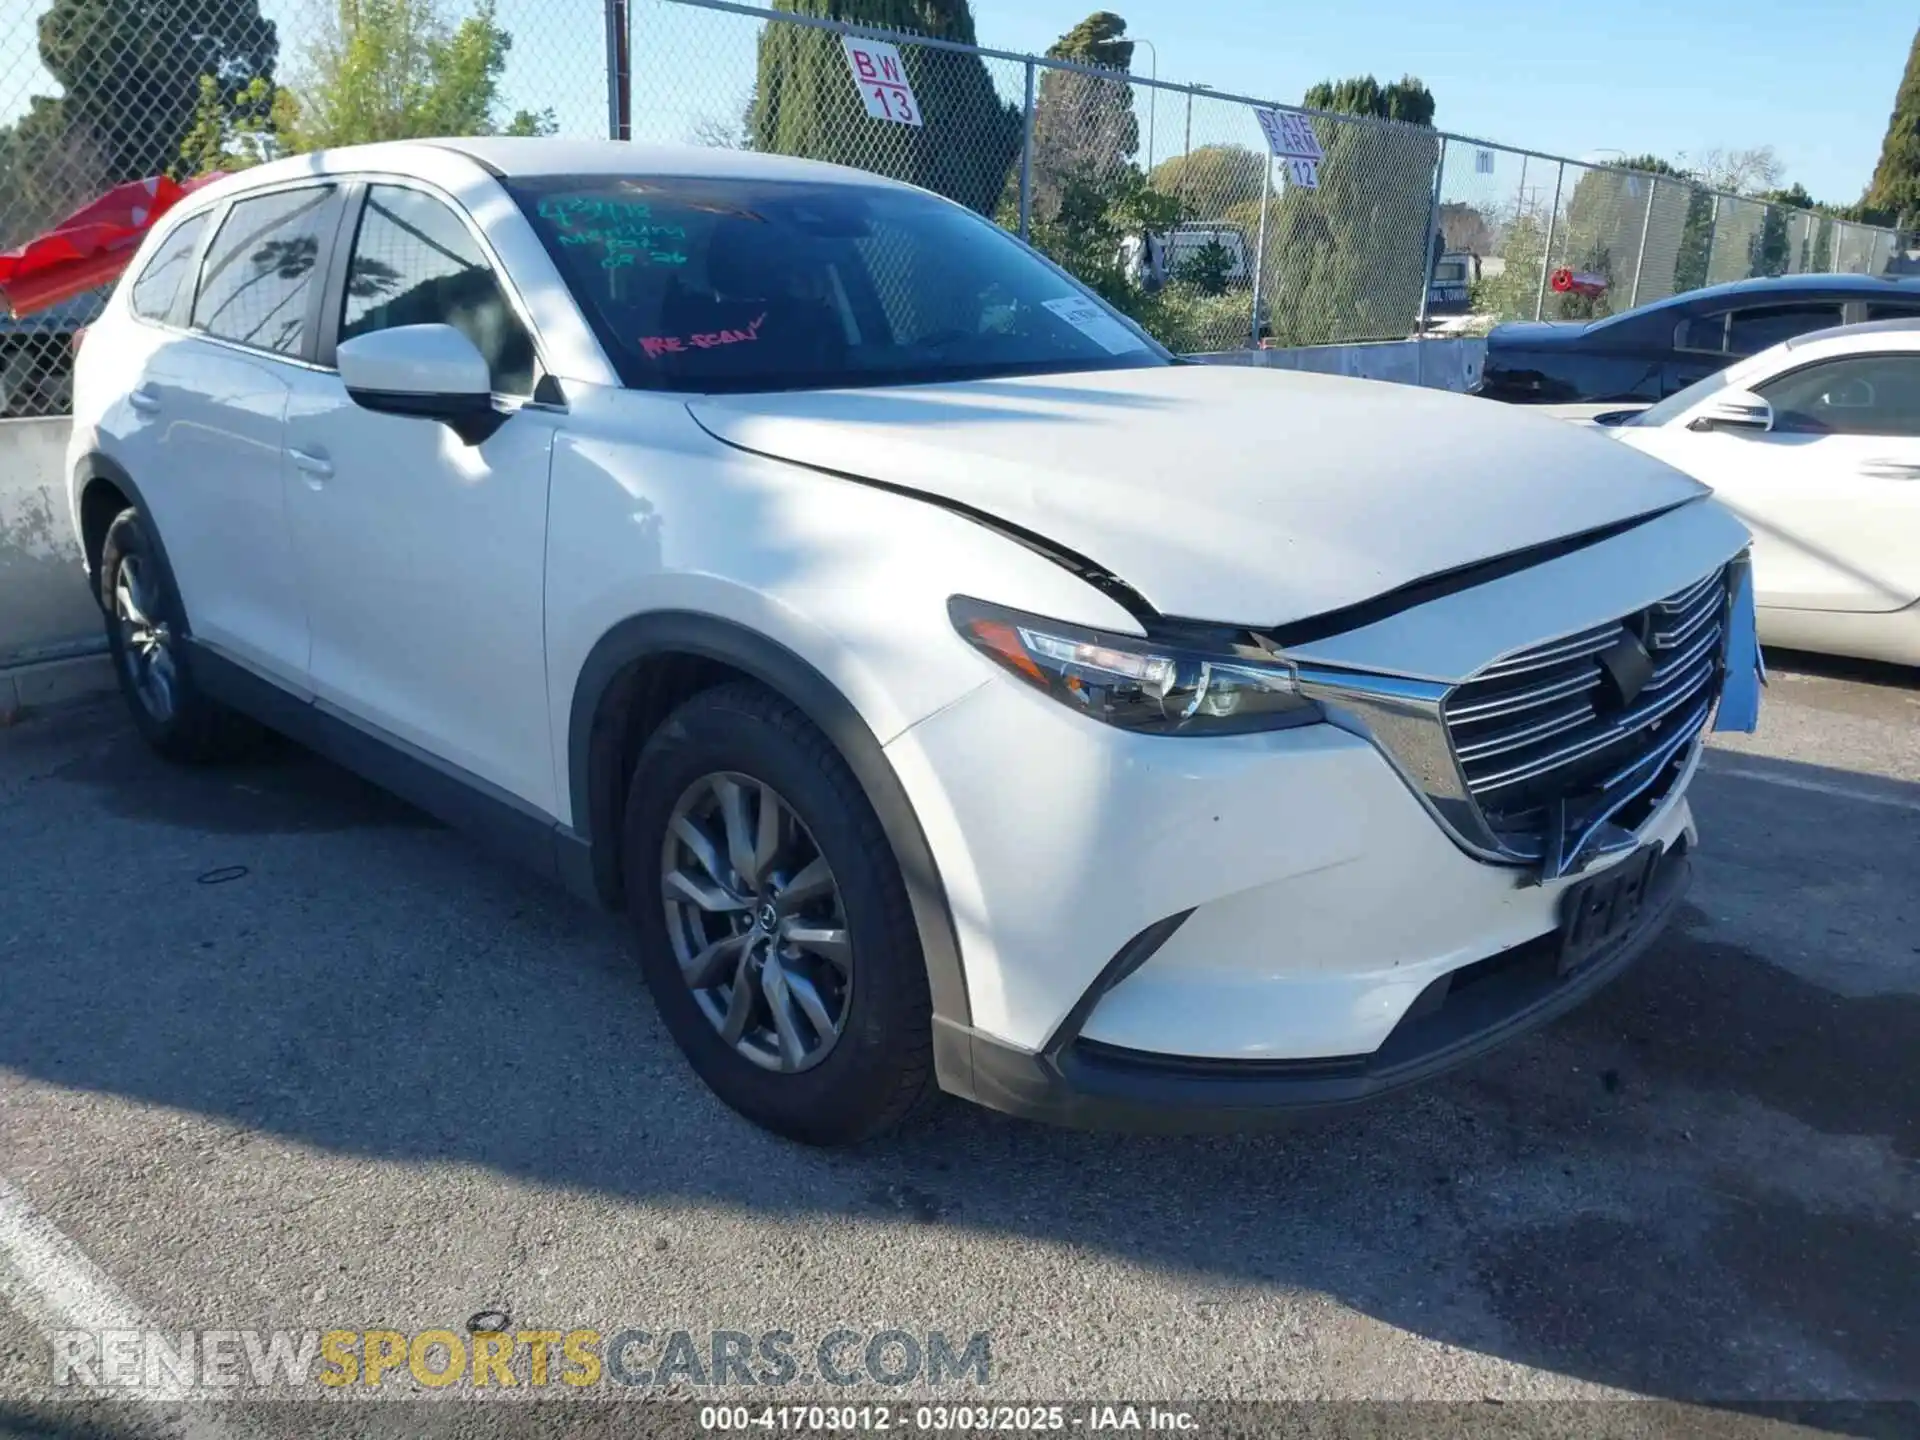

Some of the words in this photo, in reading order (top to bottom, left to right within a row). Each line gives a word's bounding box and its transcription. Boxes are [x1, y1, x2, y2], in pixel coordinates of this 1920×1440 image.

[852, 49, 900, 83] BW
[874, 87, 913, 121] 13
[1293, 160, 1315, 186] 12
